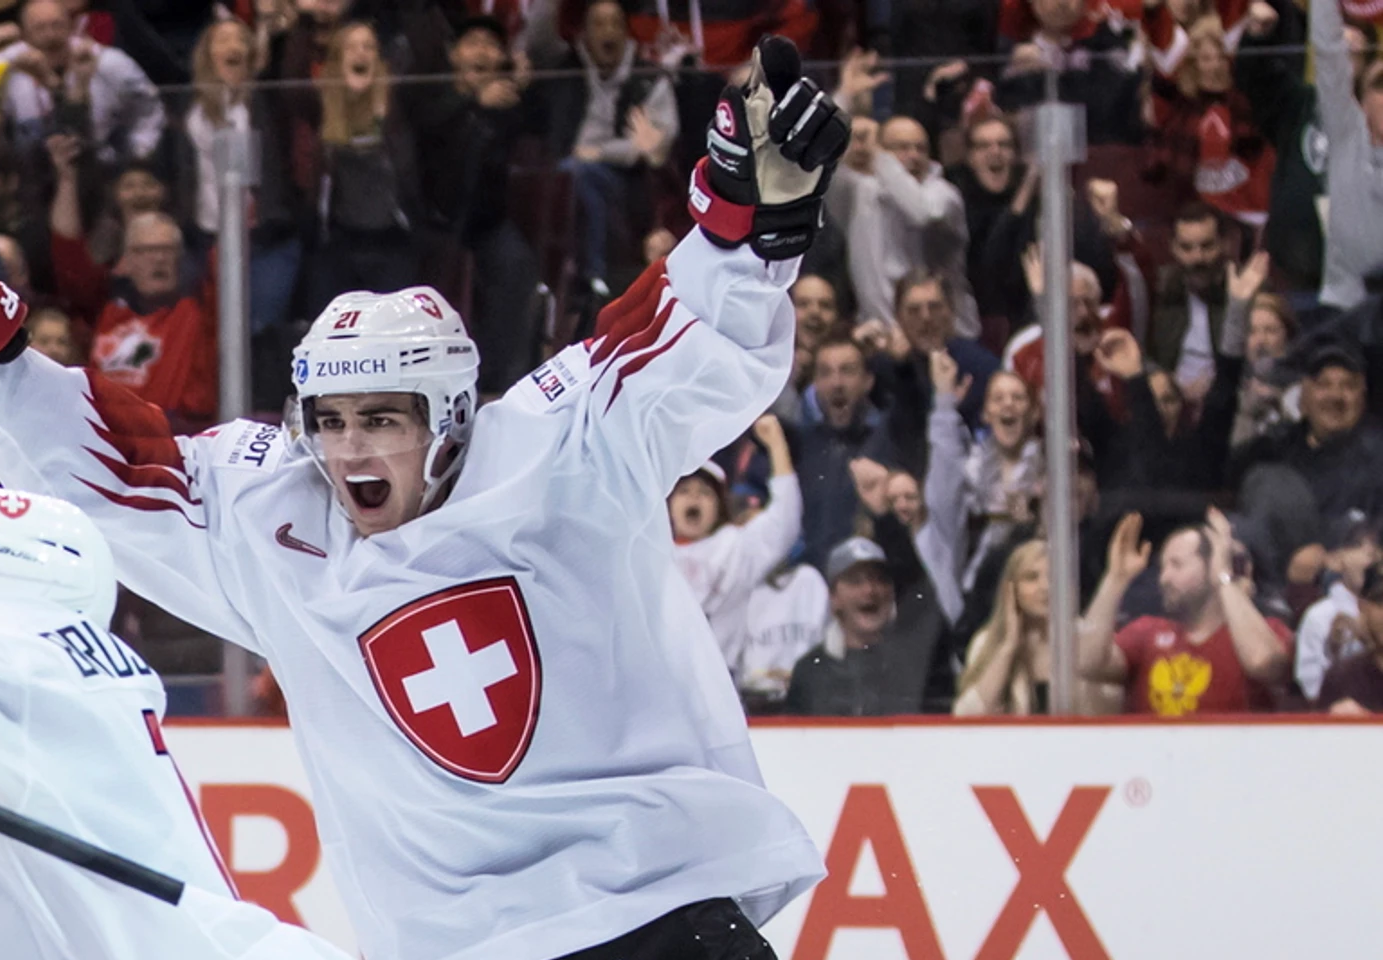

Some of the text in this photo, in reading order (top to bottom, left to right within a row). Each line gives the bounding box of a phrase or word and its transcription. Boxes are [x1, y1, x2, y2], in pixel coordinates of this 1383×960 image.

[333, 310, 362, 330] 21
[316, 359, 387, 378] ZURICH
[244, 424, 282, 468] SSOT
